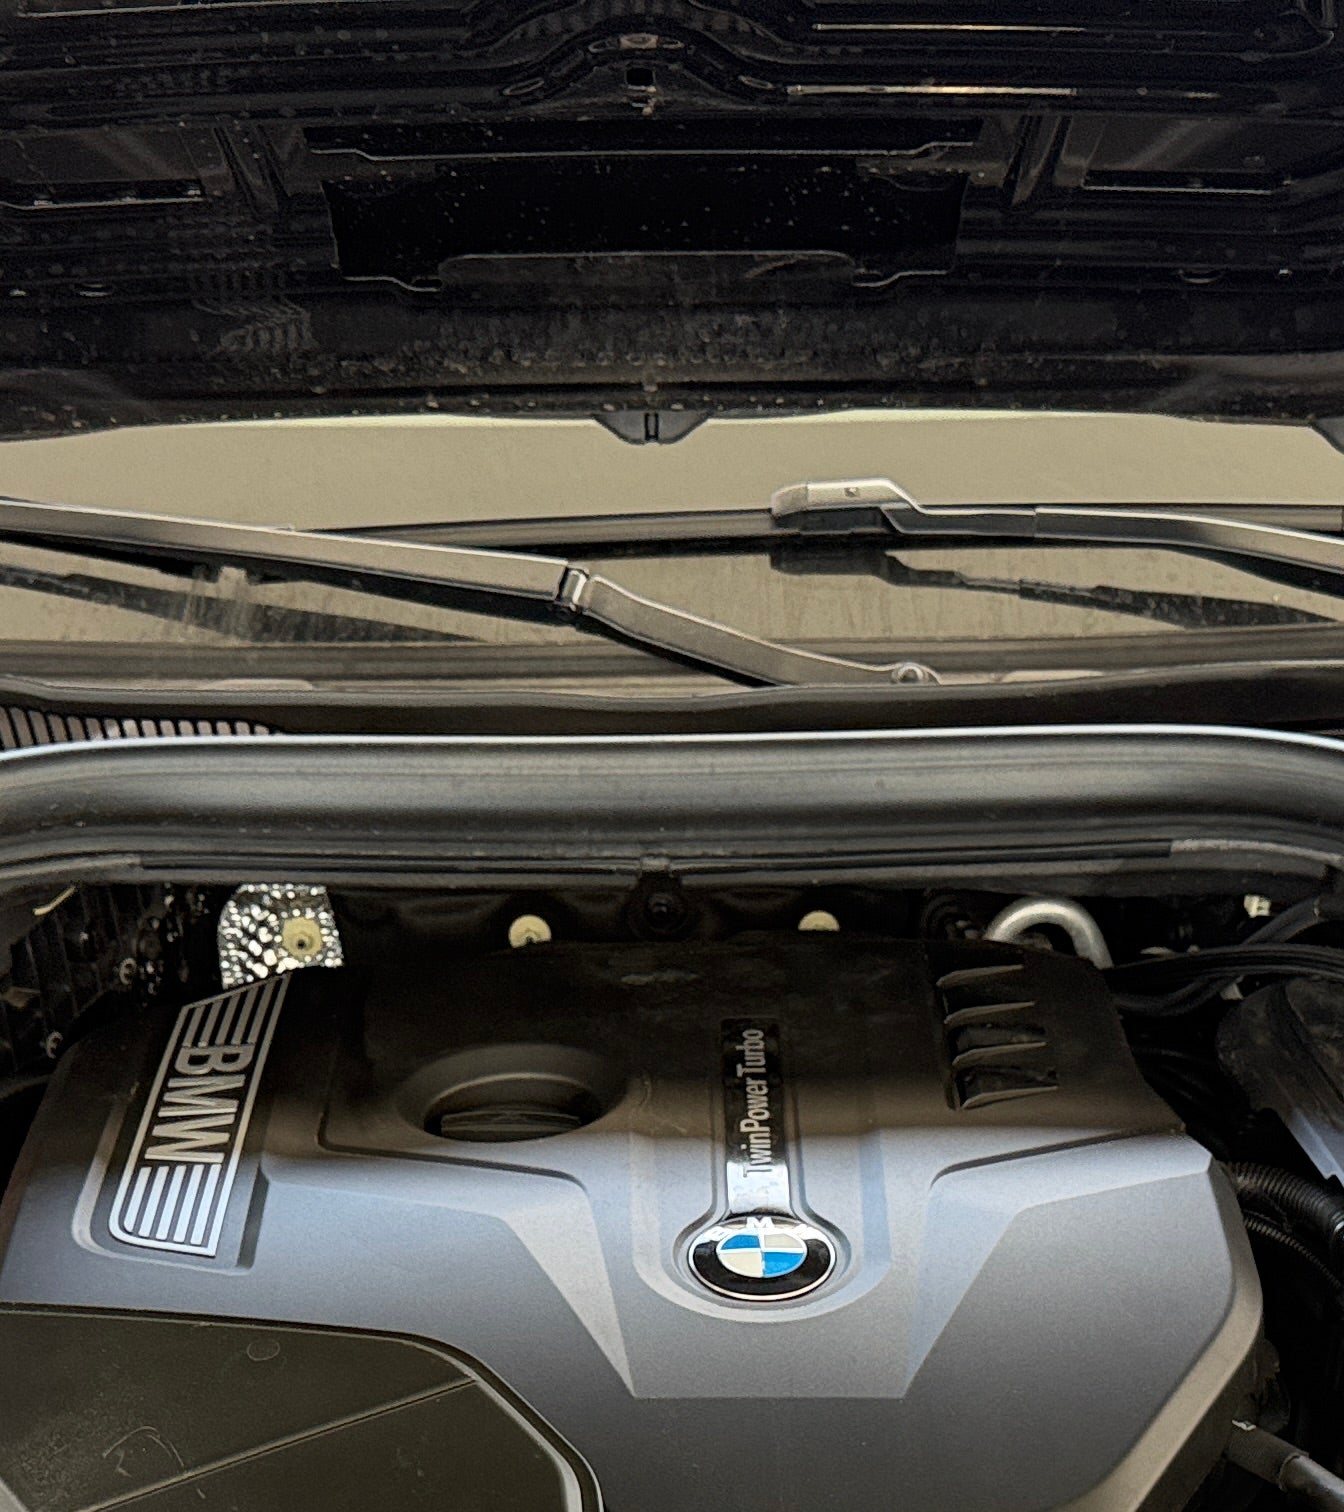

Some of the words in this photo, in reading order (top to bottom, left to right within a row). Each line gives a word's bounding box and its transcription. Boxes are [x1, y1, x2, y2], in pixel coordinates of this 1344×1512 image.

[736, 1028, 768, 1078] Turbo
[144, 1045, 255, 1164] BMW
[740, 1079, 773, 1179] TwinPower
